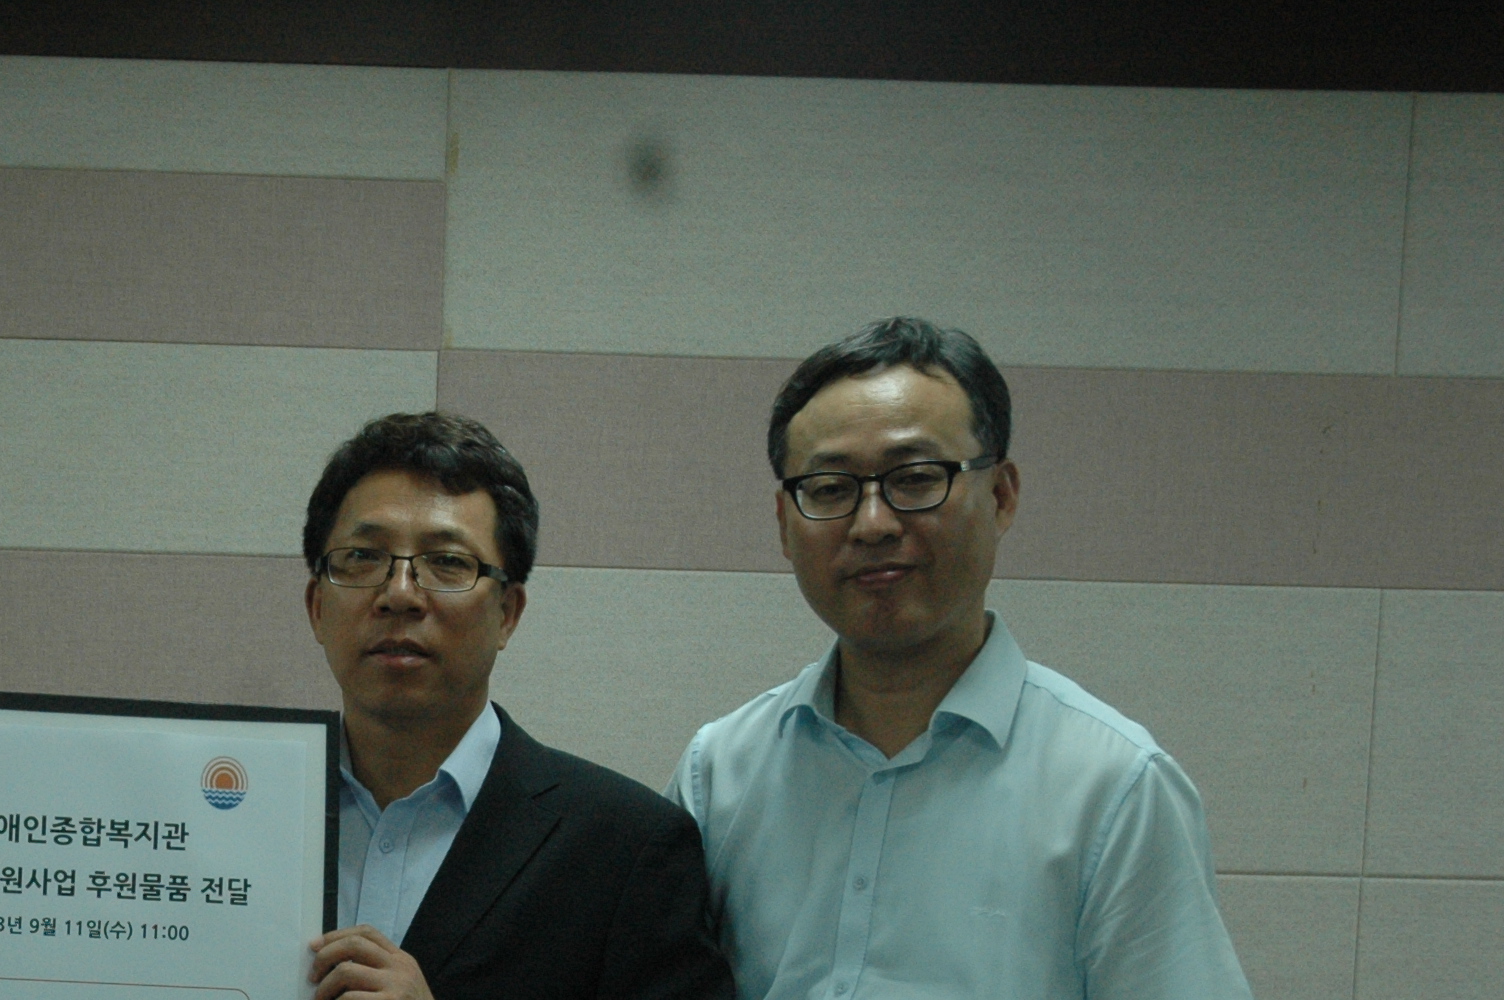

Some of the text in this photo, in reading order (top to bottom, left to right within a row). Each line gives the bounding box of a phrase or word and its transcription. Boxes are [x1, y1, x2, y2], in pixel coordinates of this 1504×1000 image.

[85, 871, 192, 903] 후원물품
[199, 876, 252, 906] 전달
[29, 916, 57, 938] 9월
[64, 919, 134, 941] 11일(수)
[140, 923, 190, 942] 11:00
